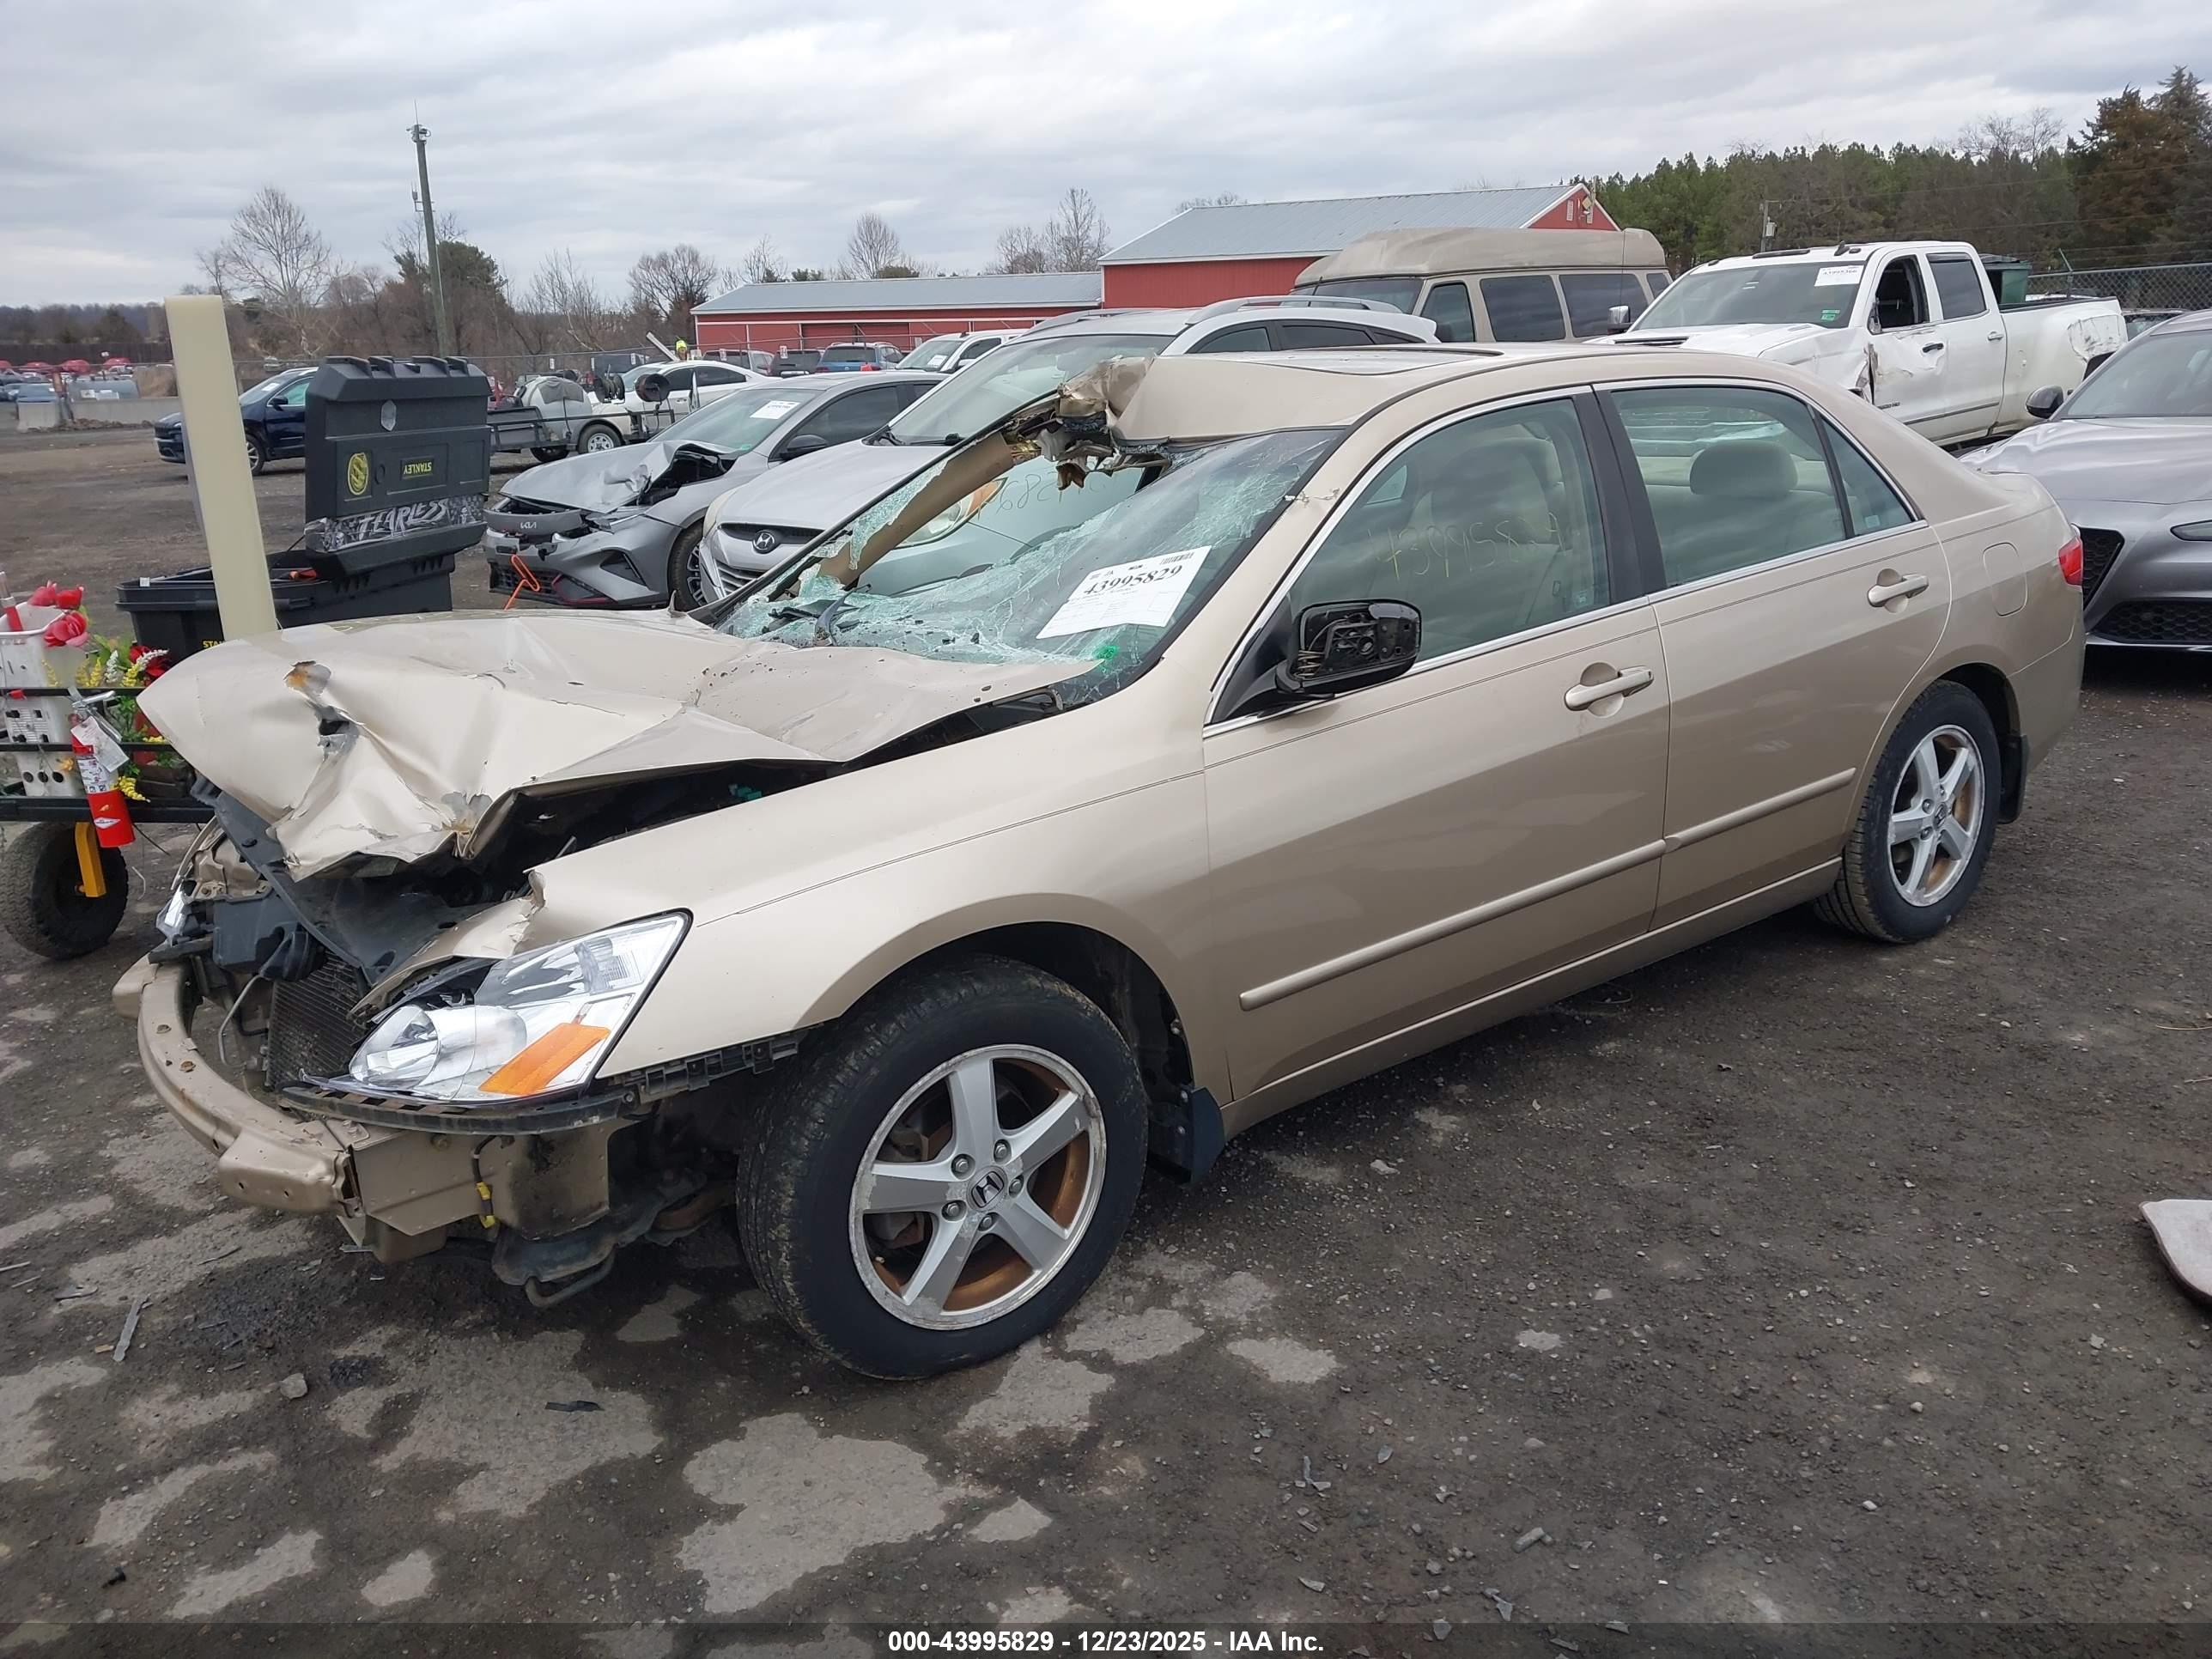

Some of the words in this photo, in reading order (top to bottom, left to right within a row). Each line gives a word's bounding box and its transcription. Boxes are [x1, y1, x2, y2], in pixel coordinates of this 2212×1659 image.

[403, 461, 432, 475] STANLEY
[357, 498, 450, 541] FEARLESS
[1084, 564, 1183, 595] 43995829
